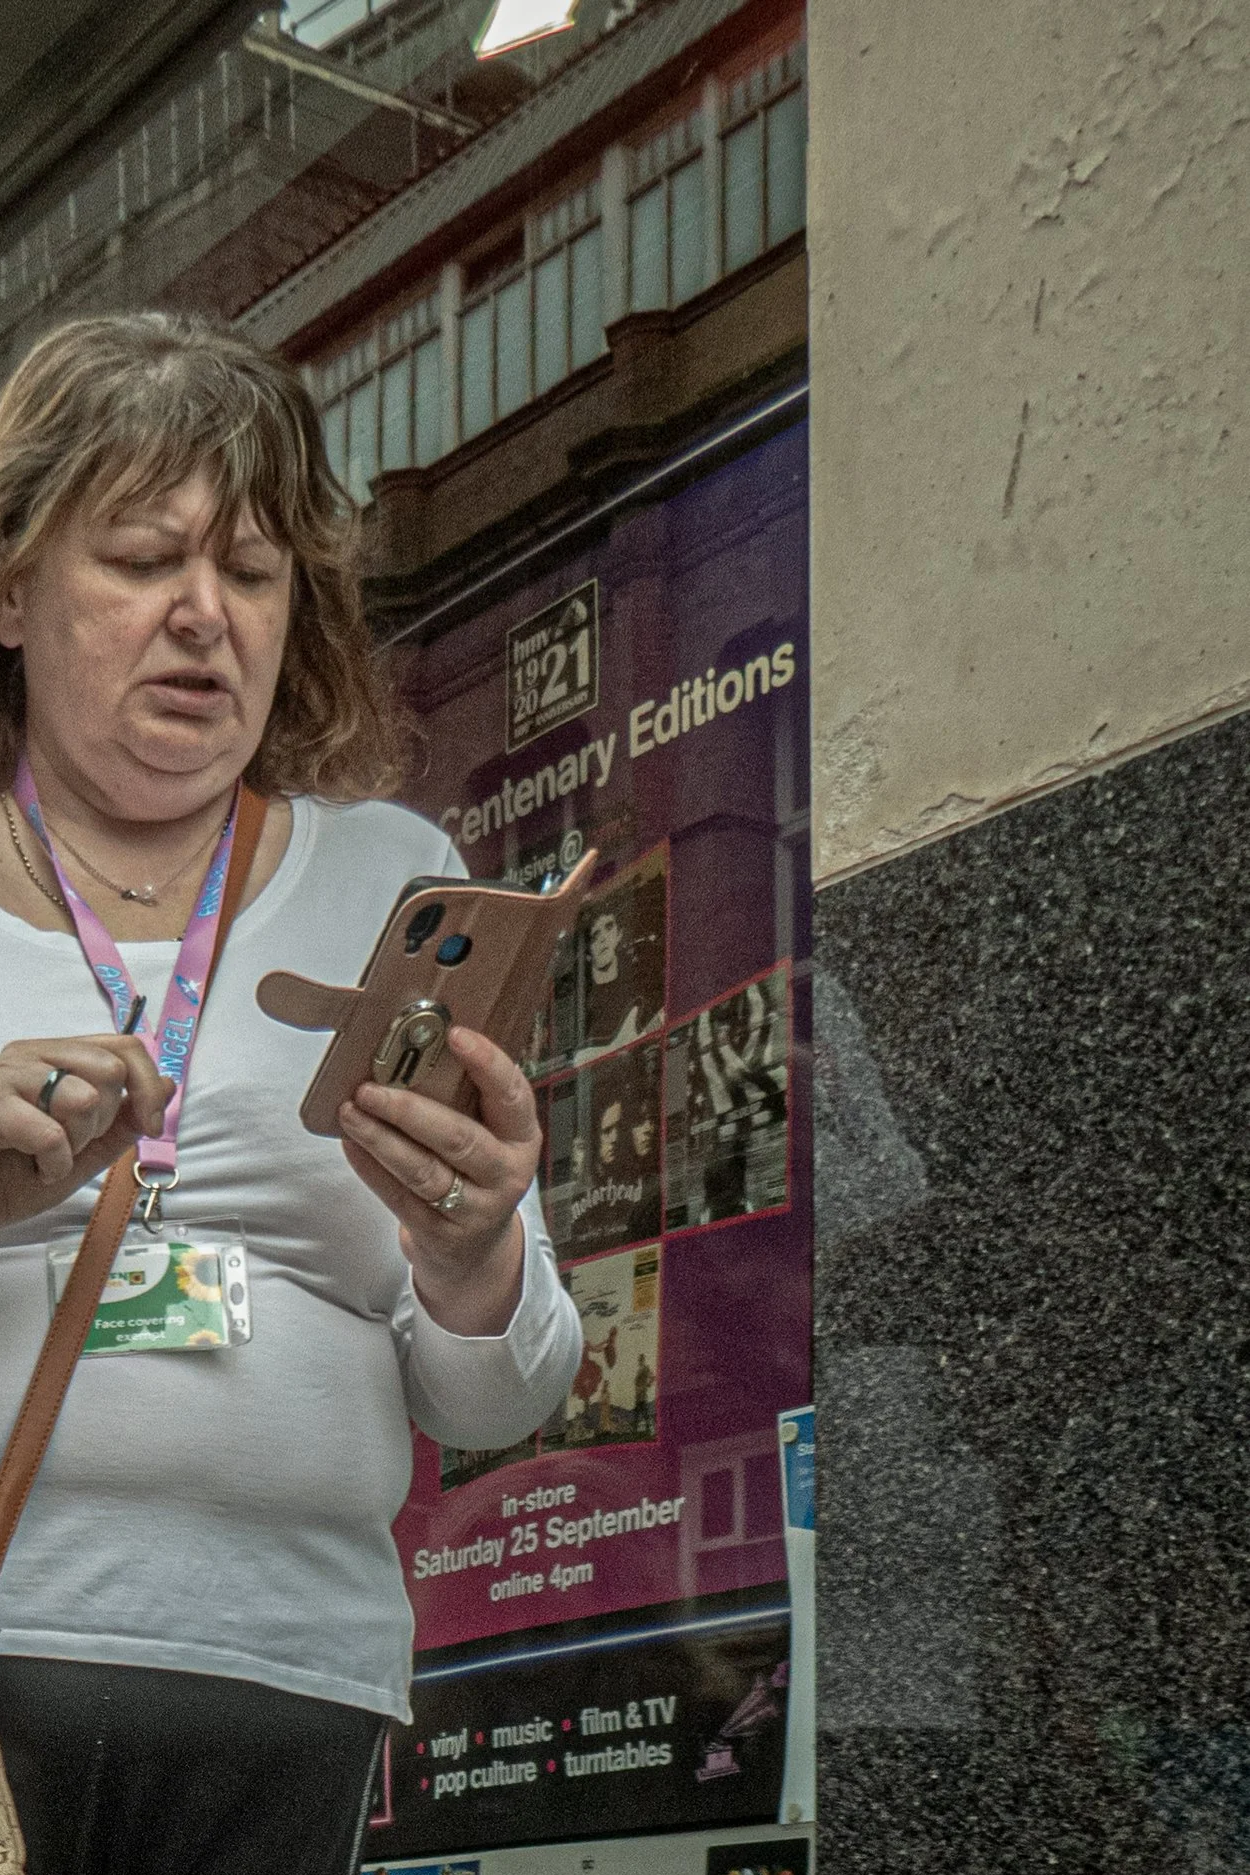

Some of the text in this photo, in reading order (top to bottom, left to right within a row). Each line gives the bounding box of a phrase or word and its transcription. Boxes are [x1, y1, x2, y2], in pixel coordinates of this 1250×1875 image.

[513, 628, 551, 665] hmv
[630, 641, 795, 759] Editions
[158, 1016, 195, 1084] NGEL
[95, 1315, 185, 1330] Face covering
[116, 1330, 166, 1343] exempt
[501, 1481, 577, 1518] in-store
[413, 1496, 687, 1581] Saturday 25 September
[490, 1561, 594, 1603] online 4pm
[431, 1696, 677, 1761] vinyl music film & TV
[434, 1740, 673, 1800] pop culture turntables
